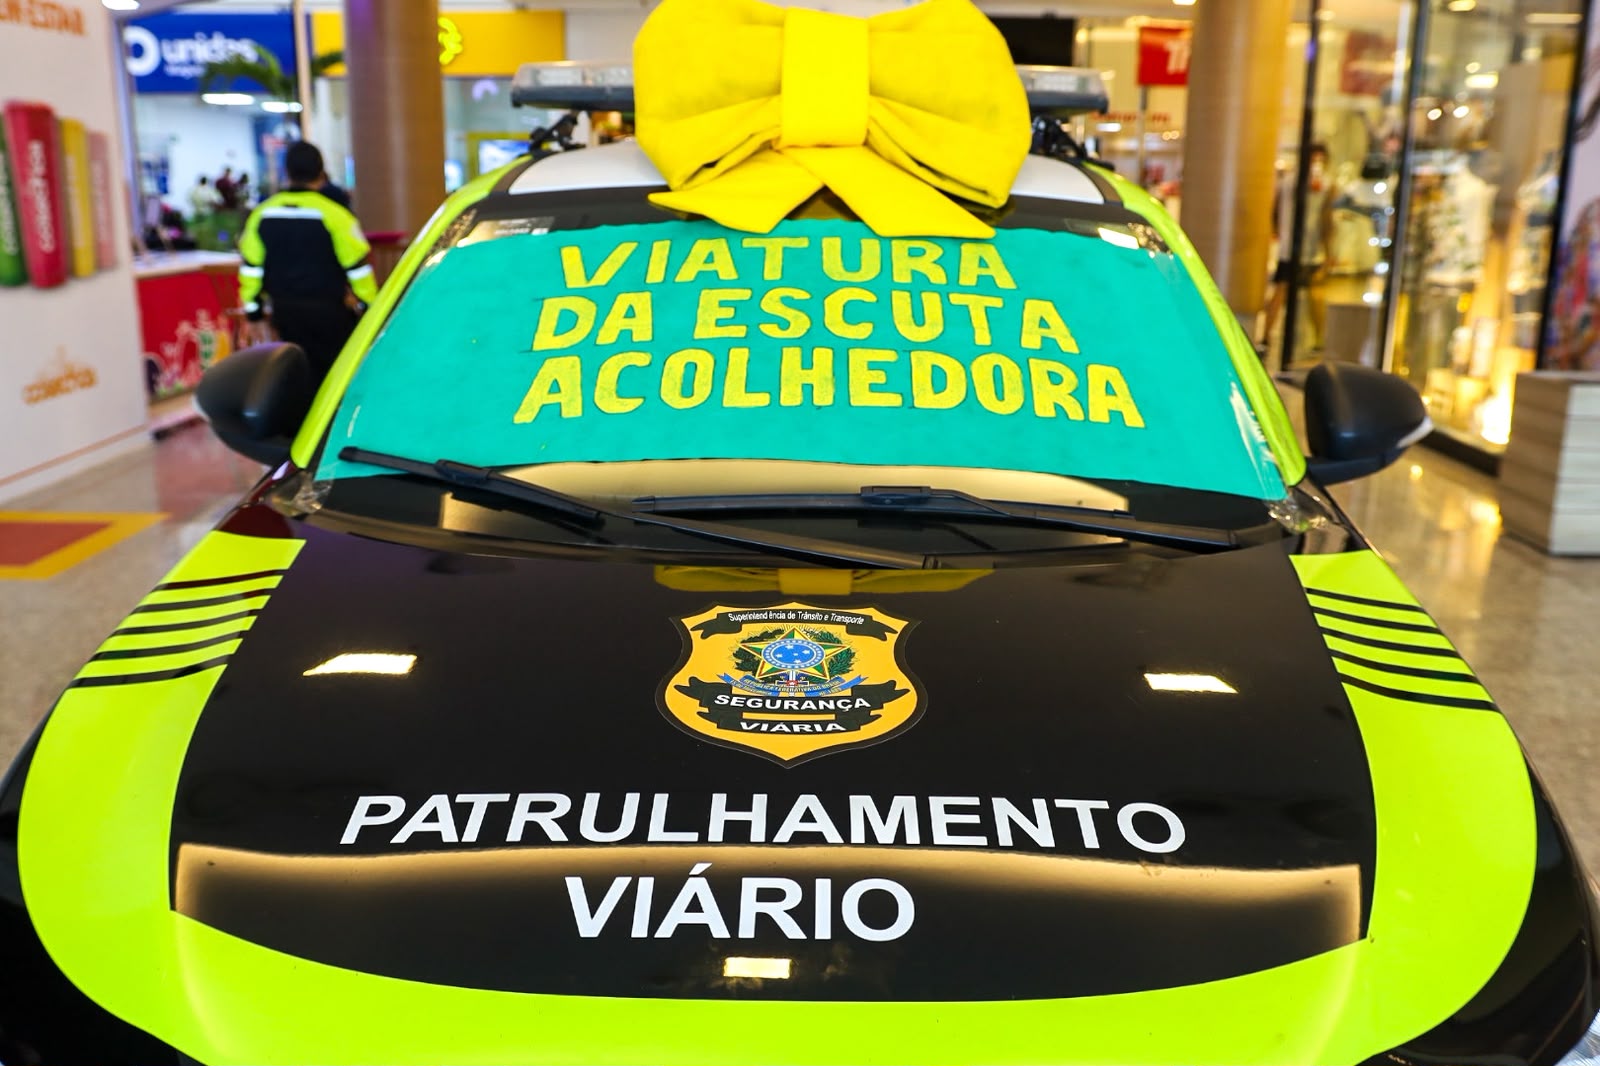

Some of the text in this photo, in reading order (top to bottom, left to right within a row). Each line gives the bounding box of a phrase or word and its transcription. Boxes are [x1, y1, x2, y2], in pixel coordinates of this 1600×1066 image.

[560, 237, 1017, 290] VIATURA
[532, 286, 1080, 355] DA ESCUTA
[513, 347, 1146, 429] ACOLHEDORA
[787, 610, 796, 620] de
[798, 611, 822, 621] Trânsito
[830, 613, 865, 625] Transporte
[714, 694, 872, 712] SEGURANÇA
[340, 792, 1186, 854] PATRULHAMENTO
[565, 863, 915, 941] VIÁRIO
